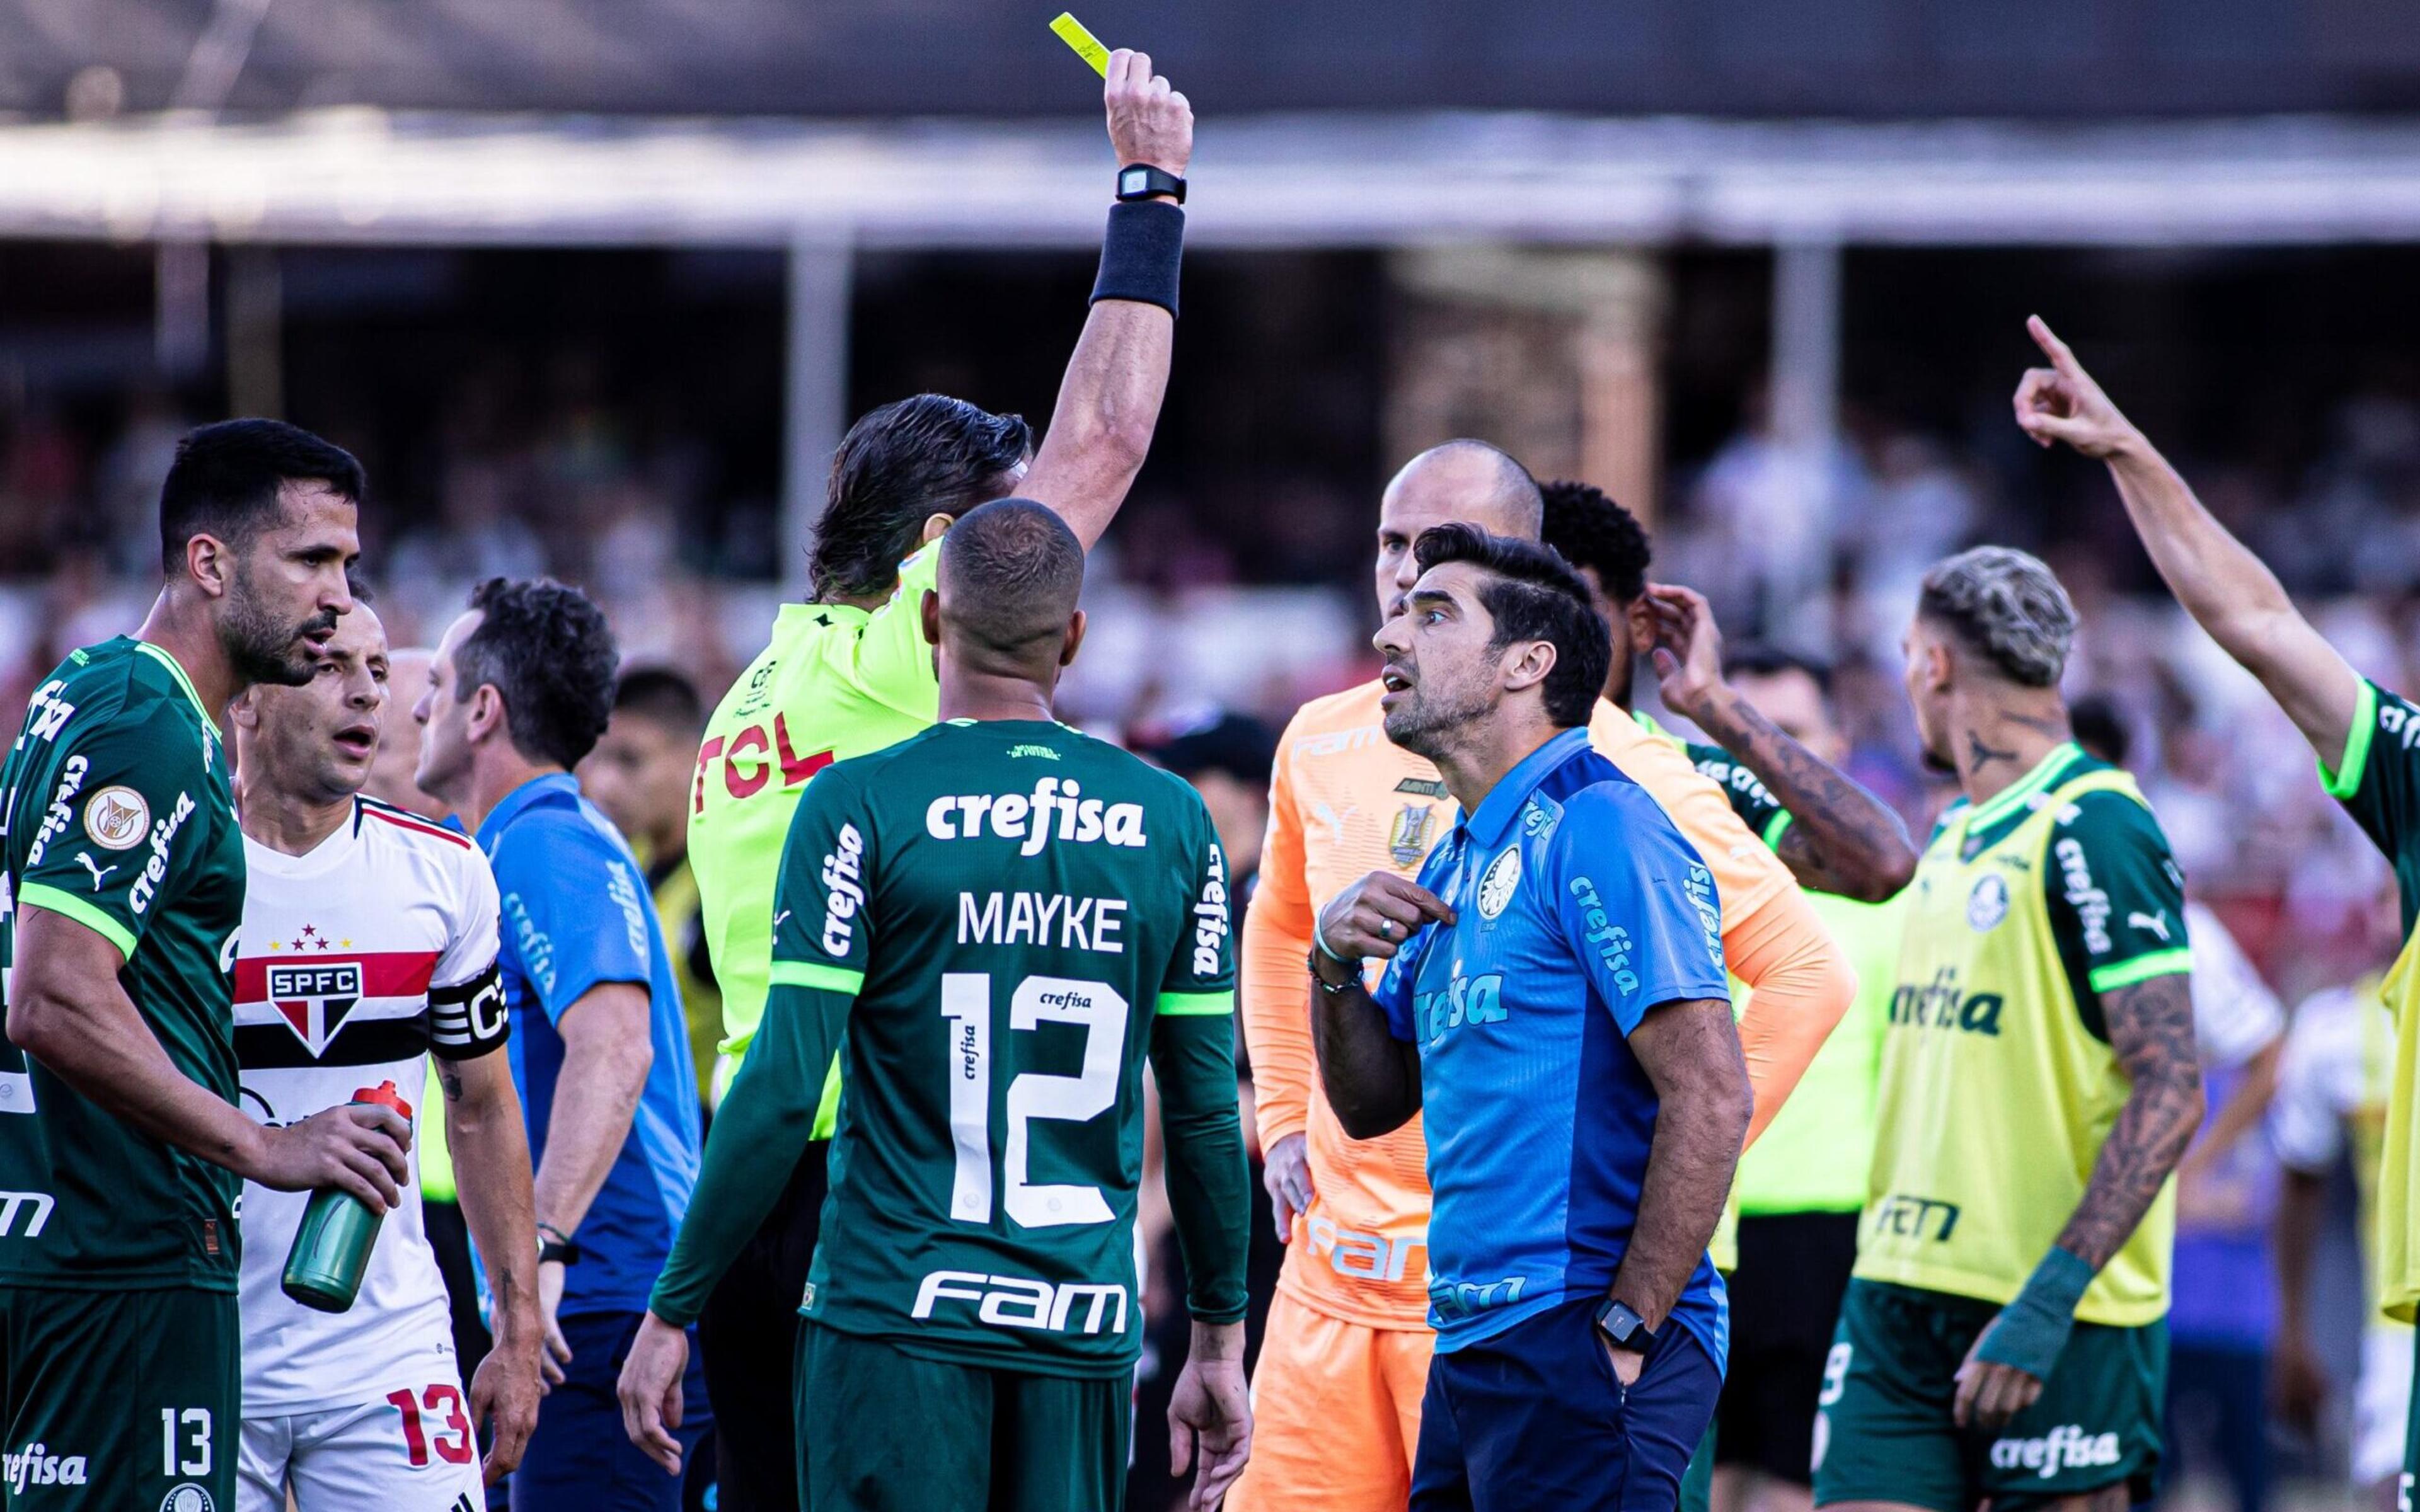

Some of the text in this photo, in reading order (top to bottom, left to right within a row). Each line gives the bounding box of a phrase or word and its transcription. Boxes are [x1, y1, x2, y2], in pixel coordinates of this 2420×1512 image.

[695, 711, 834, 815] TCL
[129, 791, 195, 915] crefisa
[926, 777, 1147, 856] crefisa
[822, 823, 864, 958] crefisa
[958, 891, 1128, 953] MAYKE
[1194, 843, 1229, 976] crefisa
[1569, 876, 1639, 997] crefisa
[1683, 865, 1724, 969] crefis
[2055, 839, 2112, 955] crefisa
[274, 971, 355, 994] SPFC
[504, 892, 556, 996] crefisa
[1039, 991, 1092, 1009] crefisa
[965, 1025, 976, 1080] crefisa
[941, 973, 1129, 1228] 12
[911, 1269, 1127, 1334] Fam
[161, 1408, 212, 1476] 13
[386, 1384, 474, 1466] 13
[1990, 1424, 2121, 1479] crefisa
